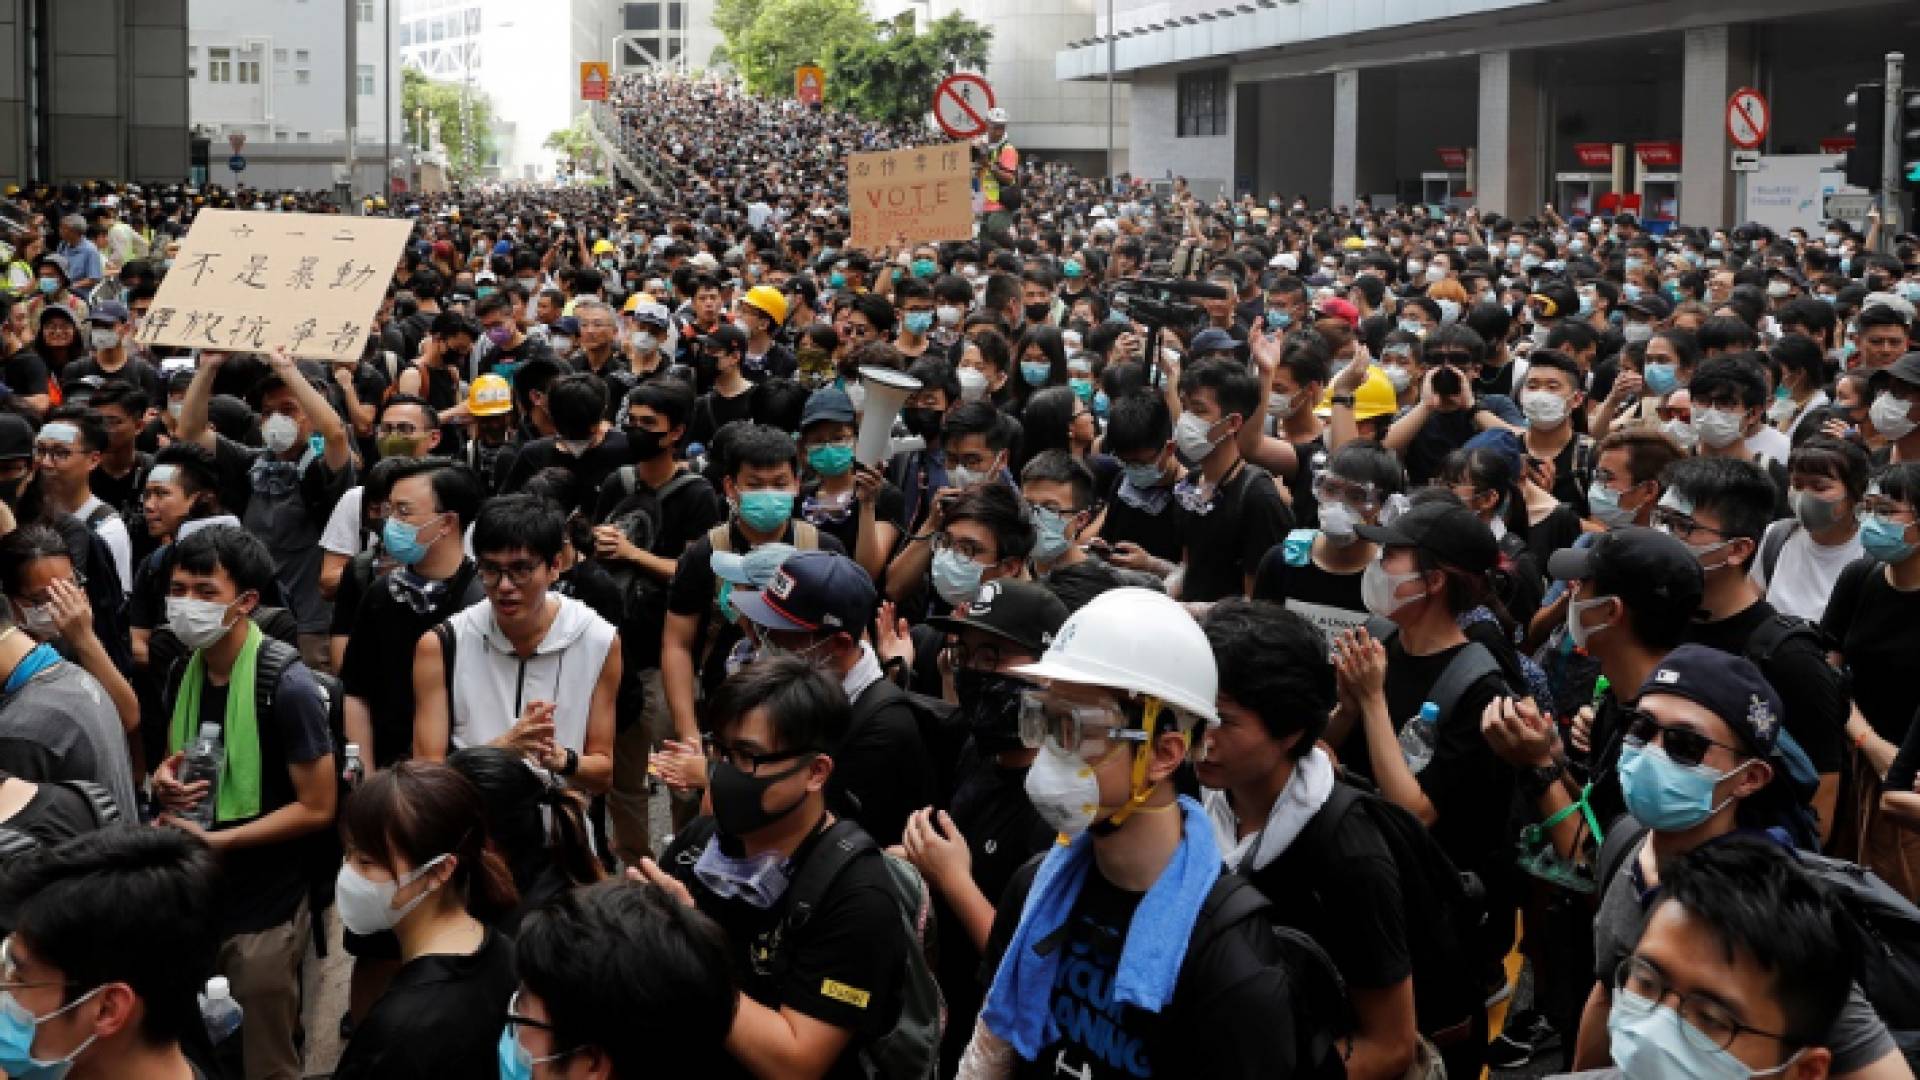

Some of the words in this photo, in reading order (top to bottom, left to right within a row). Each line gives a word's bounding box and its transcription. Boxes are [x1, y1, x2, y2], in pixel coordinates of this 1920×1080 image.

[866, 181, 949, 210] VOTE
[180, 253, 376, 292] 不是暴動
